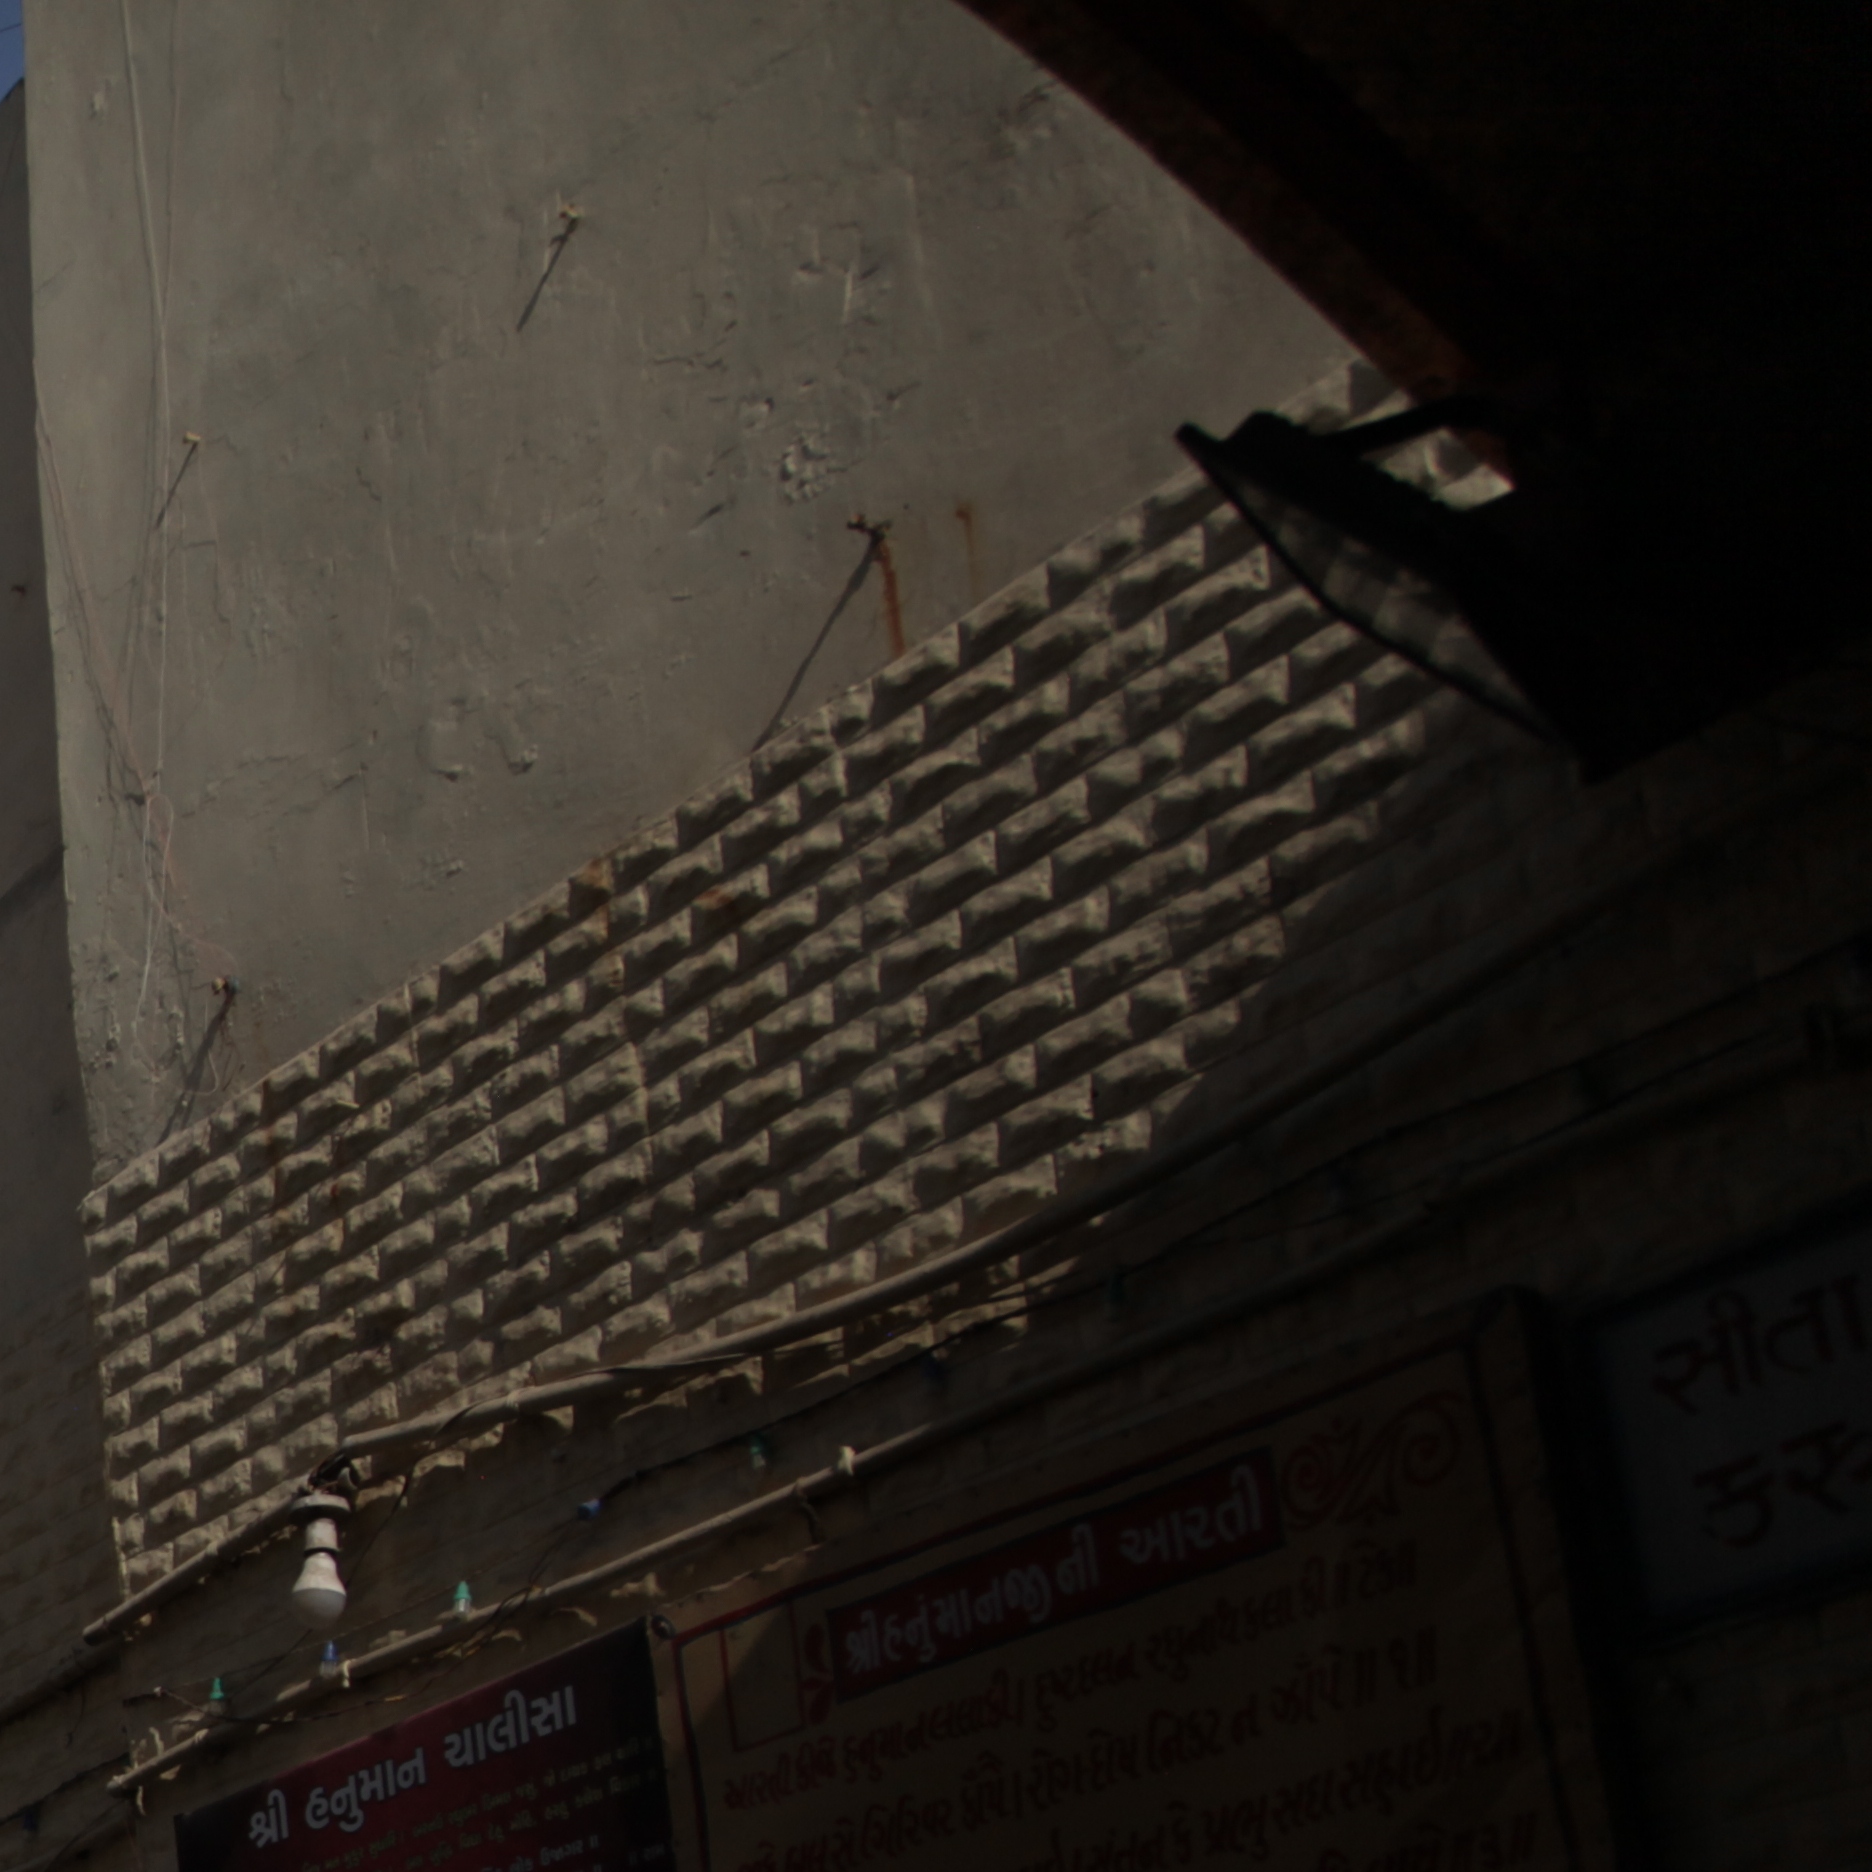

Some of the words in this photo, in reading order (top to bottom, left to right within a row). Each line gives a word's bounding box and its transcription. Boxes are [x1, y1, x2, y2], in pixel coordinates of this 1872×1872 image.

[1120, 1465, 1260, 1563] આરતી
[249, 1789, 288, 1847] શ્રી
[305, 1748, 425, 1831] હનુમાન
[444, 1686, 575, 1766] ચાલીસા
